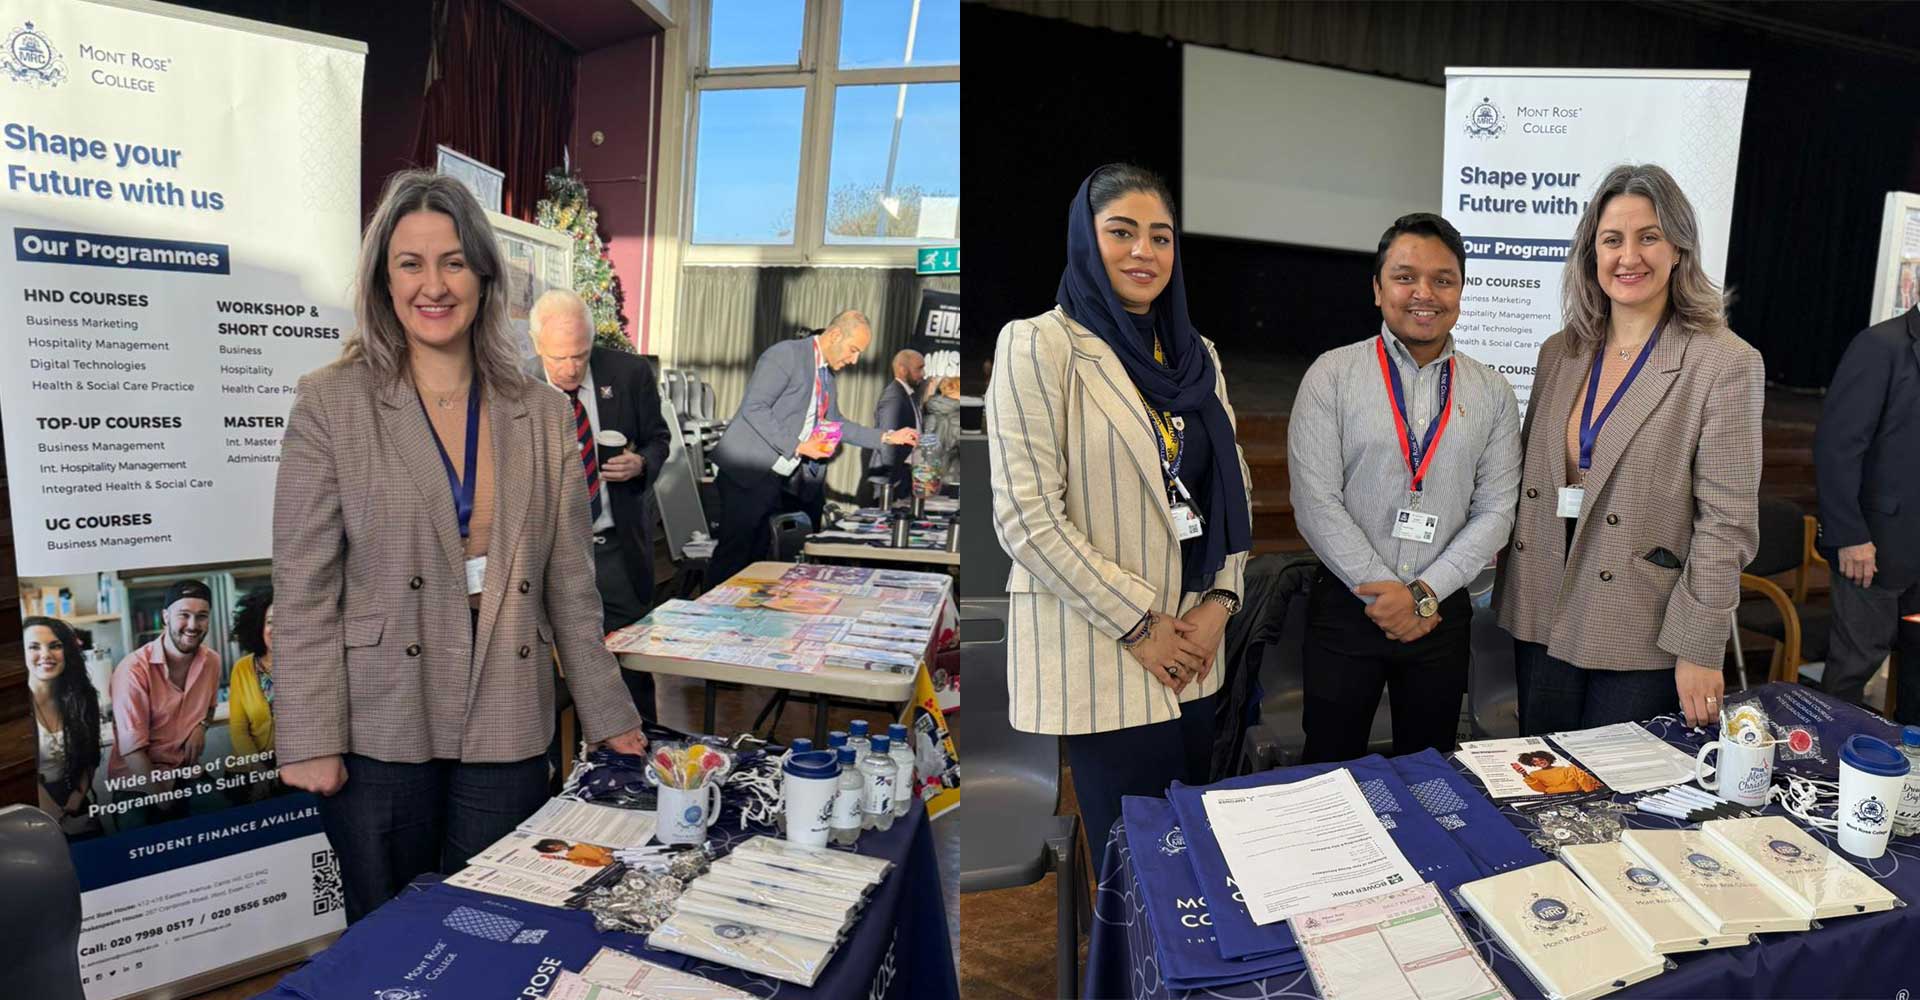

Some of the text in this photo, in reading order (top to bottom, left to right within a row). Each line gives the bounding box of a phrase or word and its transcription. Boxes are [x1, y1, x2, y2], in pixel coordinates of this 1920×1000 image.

[20, 51, 45, 64] MRC
[79, 44, 126, 65] MONT
[91, 70, 156, 93] COLLEGE
[1517, 106, 1549, 117] MONT
[1523, 123, 1567, 134] COLLEGE
[3, 122, 182, 169] Shape your
[1460, 166, 1580, 190] Shape your
[7, 164, 225, 211] Future with us
[1458, 194, 1578, 214] Future with
[22, 235, 220, 268] Our Programmes
[1463, 241, 1491, 254] Our
[1465, 277, 1541, 289] ND COURSES
[24, 288, 149, 307] HND COURSES
[1491, 296, 1531, 306] Marketing
[216, 301, 319, 318] WORKSHOP &
[1461, 310, 1551, 320] ospitality Management
[26, 315, 139, 331] Business Marketing
[1455, 324, 1533, 335] Digital Technologies
[218, 323, 340, 339] SHORT COURSES
[28, 337, 170, 351] Hospitality Management
[1454, 338, 1480, 346] Health
[1489, 339, 1512, 347] Social
[219, 345, 262, 355] Business
[30, 359, 147, 372] Digital Technologies
[220, 365, 273, 376] Hospitality
[32, 380, 195, 392] Health & Social Care Practice
[221, 385, 254, 394] Health
[256, 385, 280, 394] Care
[36, 416, 182, 430] TOP-UP COURSES
[224, 417, 284, 428] MASTER
[38, 441, 165, 453] Business Management
[226, 438, 277, 447] Int. Master
[40, 461, 187, 474] Int. Hospitality Management
[42, 479, 213, 495] Integrated Health & Social Care
[45, 513, 152, 531] UG COURSES
[47, 534, 172, 550] Business Management
[104, 749, 274, 792] Wide Range of Career
[88, 787, 192, 818] Programmes
[196, 782, 212, 795] to
[216, 774, 246, 791] Suit
[129, 835, 194, 860] STUDENT
[197, 821, 257, 844] FINANCE
[1356, 881, 1387, 893] BOWER
[1540, 907, 1565, 919] MRC
[80, 943, 107, 957] Call:
[110, 936, 132, 948] 020
[135, 927, 163, 941] 7998
[167, 918, 194, 933] 0517
[200, 913, 206, 925] /
[211, 908, 231, 920] 020
[234, 900, 260, 914] 8556
[262, 892, 287, 905] 5009
[425, 953, 458, 981] COLLEGE
[523, 957, 562, 998] ROSE
